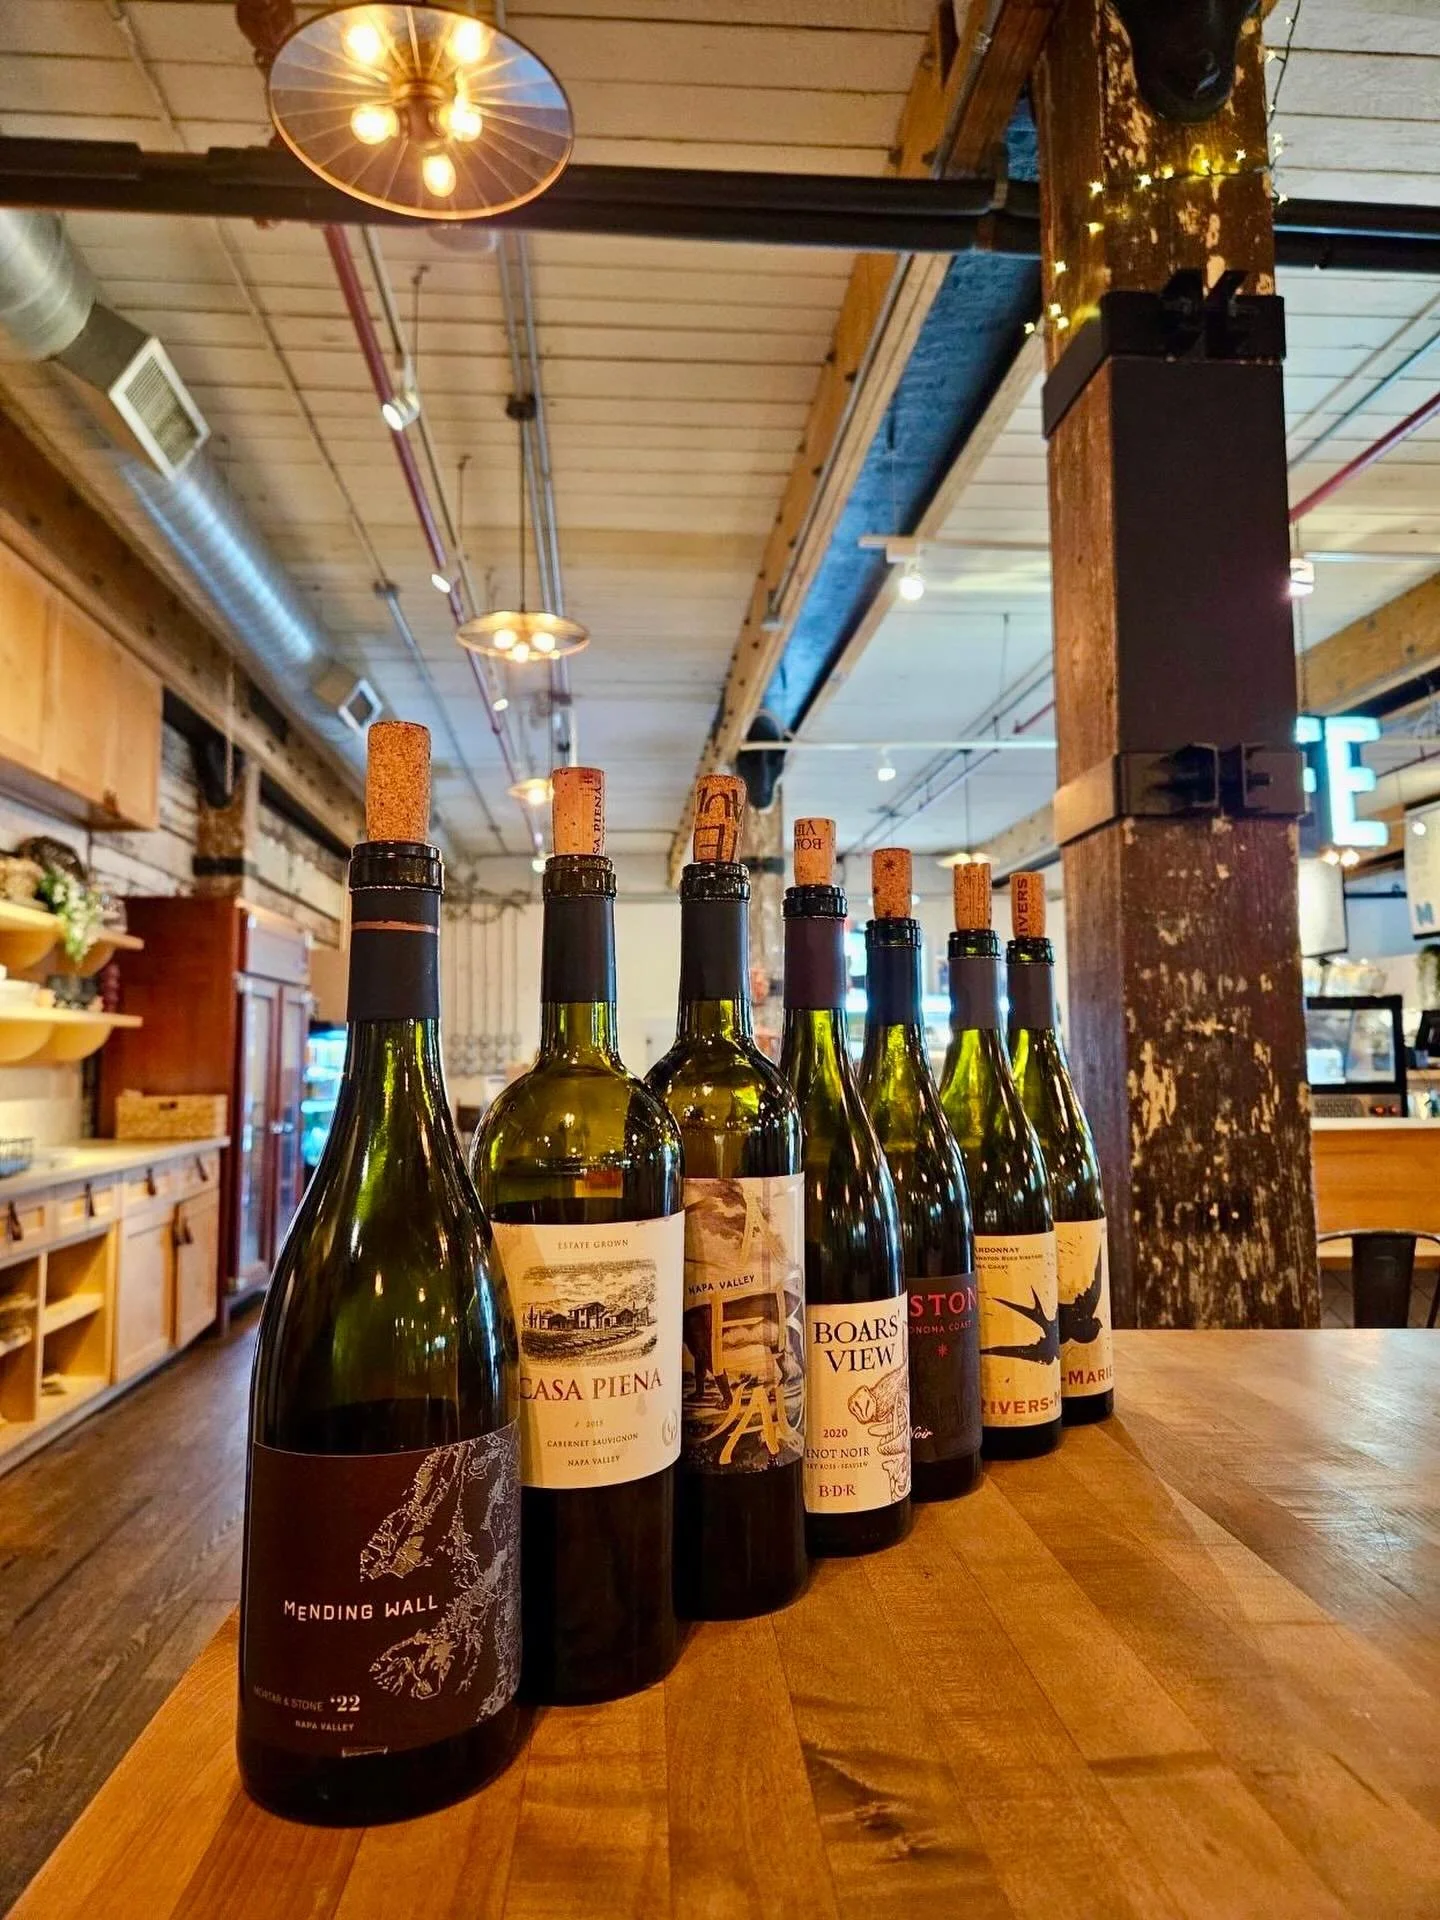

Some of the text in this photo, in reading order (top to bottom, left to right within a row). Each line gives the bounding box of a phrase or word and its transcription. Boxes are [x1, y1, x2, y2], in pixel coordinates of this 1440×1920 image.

[558, 1239, 629, 1249] ESTATE GROWN
[688, 1274, 755, 1296] NAPA VALLEY
[824, 1343, 896, 1373] VIEW
[519, 1367, 663, 1401] CASA PIENA
[547, 1432, 639, 1448] CABERNET SAUVIGNON
[823, 1428, 848, 1438] 2020
[840, 1446, 870, 1459] NOIR
[567, 1455, 621, 1467] NAPA VALLEY
[284, 1594, 438, 1622] MENDING WALL
[290, 1697, 324, 1713] STONE
[295, 1719, 355, 1732] NAPA VALLEY
